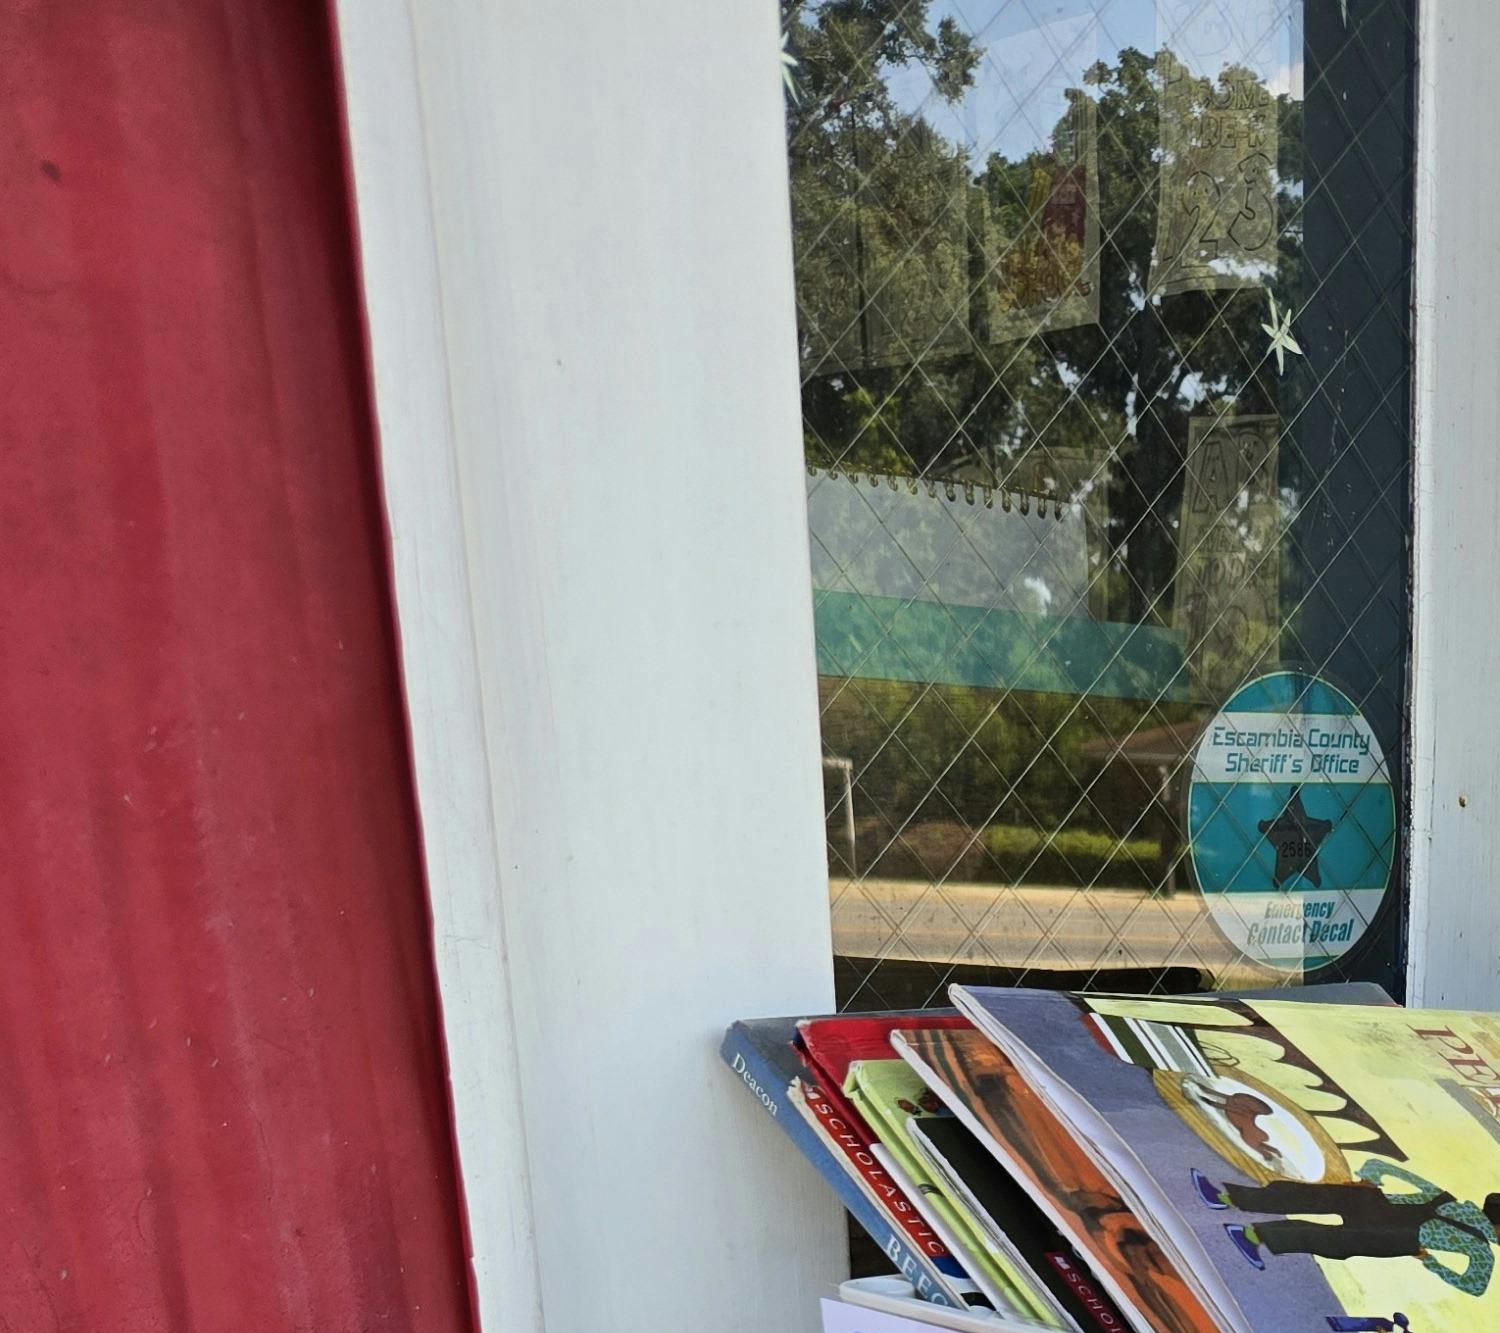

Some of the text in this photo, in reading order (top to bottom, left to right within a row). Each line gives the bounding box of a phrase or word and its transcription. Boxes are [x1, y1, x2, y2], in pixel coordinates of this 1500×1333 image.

[1212, 726, 1370, 756] Escambia County
[1225, 753, 1360, 774] Sheriff's Office
[1264, 900, 1335, 921] Emergency
[1247, 918, 1354, 946] Contact Decal
[731, 1053, 778, 1117] Deacon
[815, 1103, 945, 1255] SCHOLASTIC
